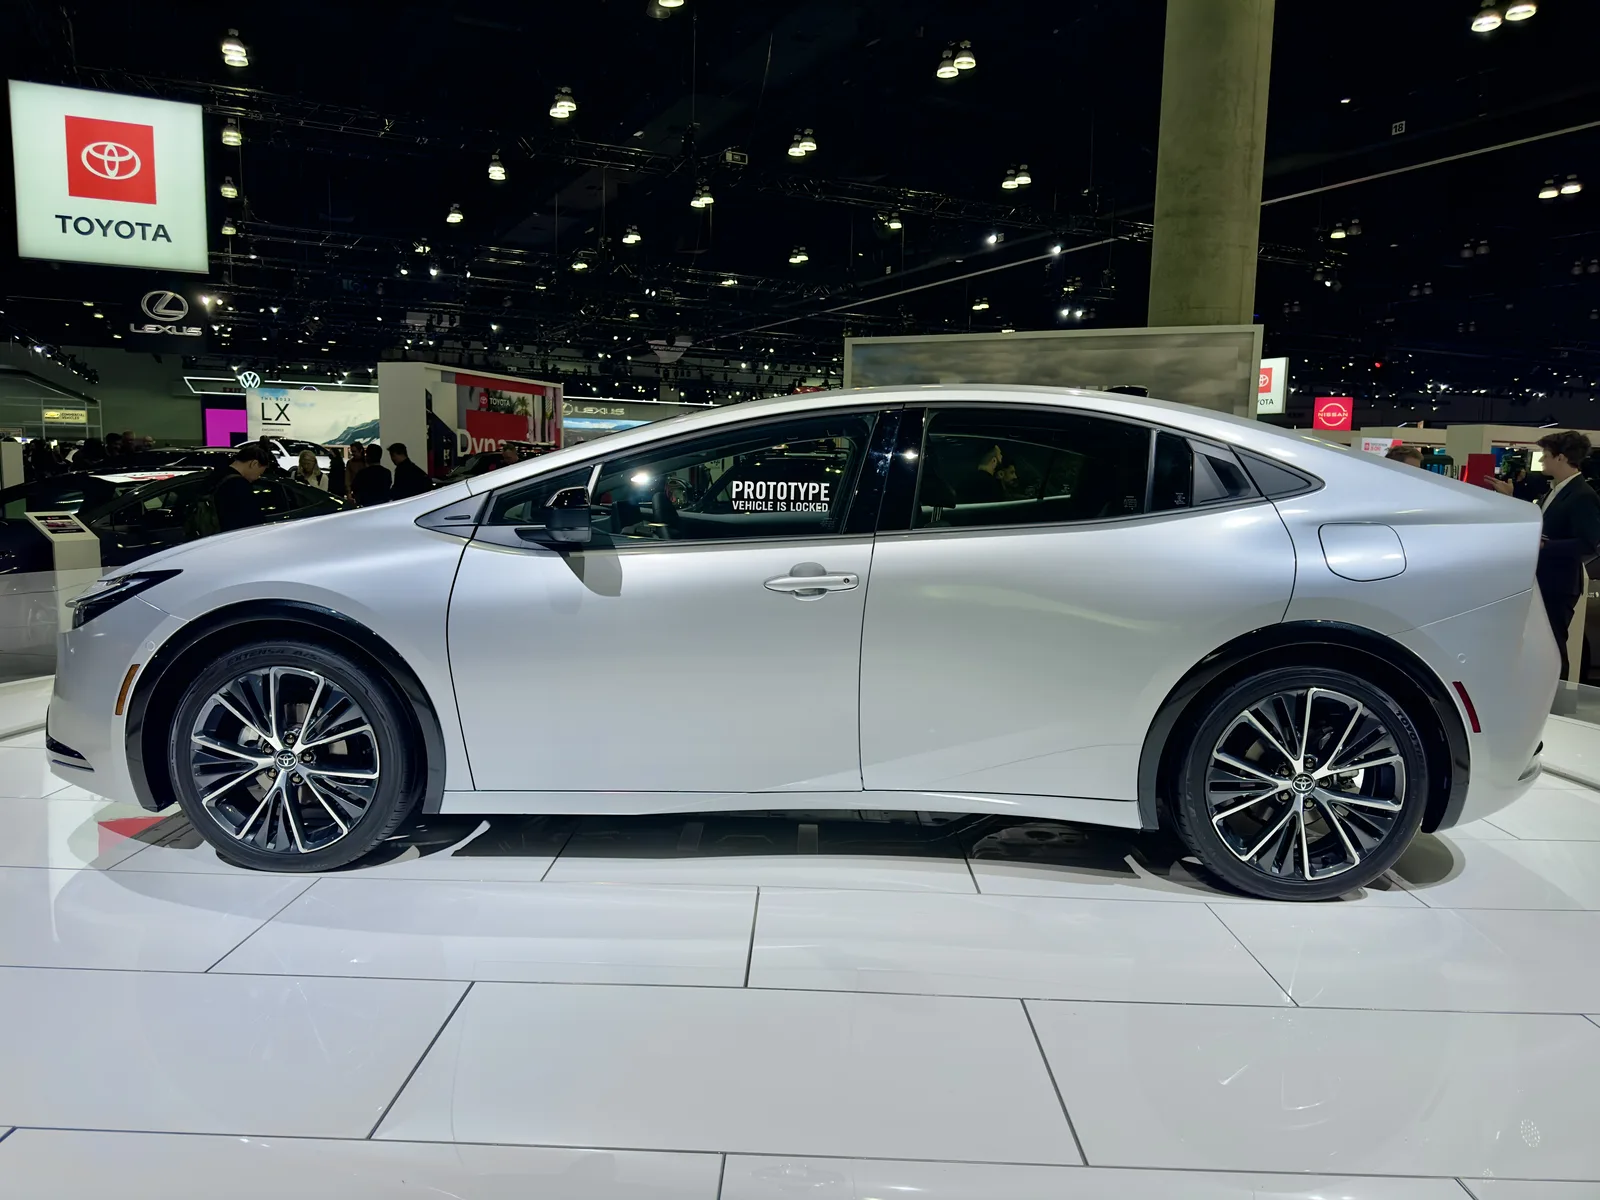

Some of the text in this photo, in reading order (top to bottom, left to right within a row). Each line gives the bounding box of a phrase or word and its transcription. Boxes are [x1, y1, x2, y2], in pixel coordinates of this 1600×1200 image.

[1394, 124, 1403, 133] 18
[55, 214, 172, 243] TOYOTA
[129, 322, 203, 337] LEXUS
[489, 396, 511, 407] TOYOTA
[1257, 398, 1274, 406] OTA
[262, 402, 290, 421] LX
[574, 407, 625, 416] LEXUS
[731, 480, 830, 501] PROTOTYPE
[732, 500, 828, 512] VEHICLE IS LOCKED
[1396, 710, 1417, 740] TOYO
